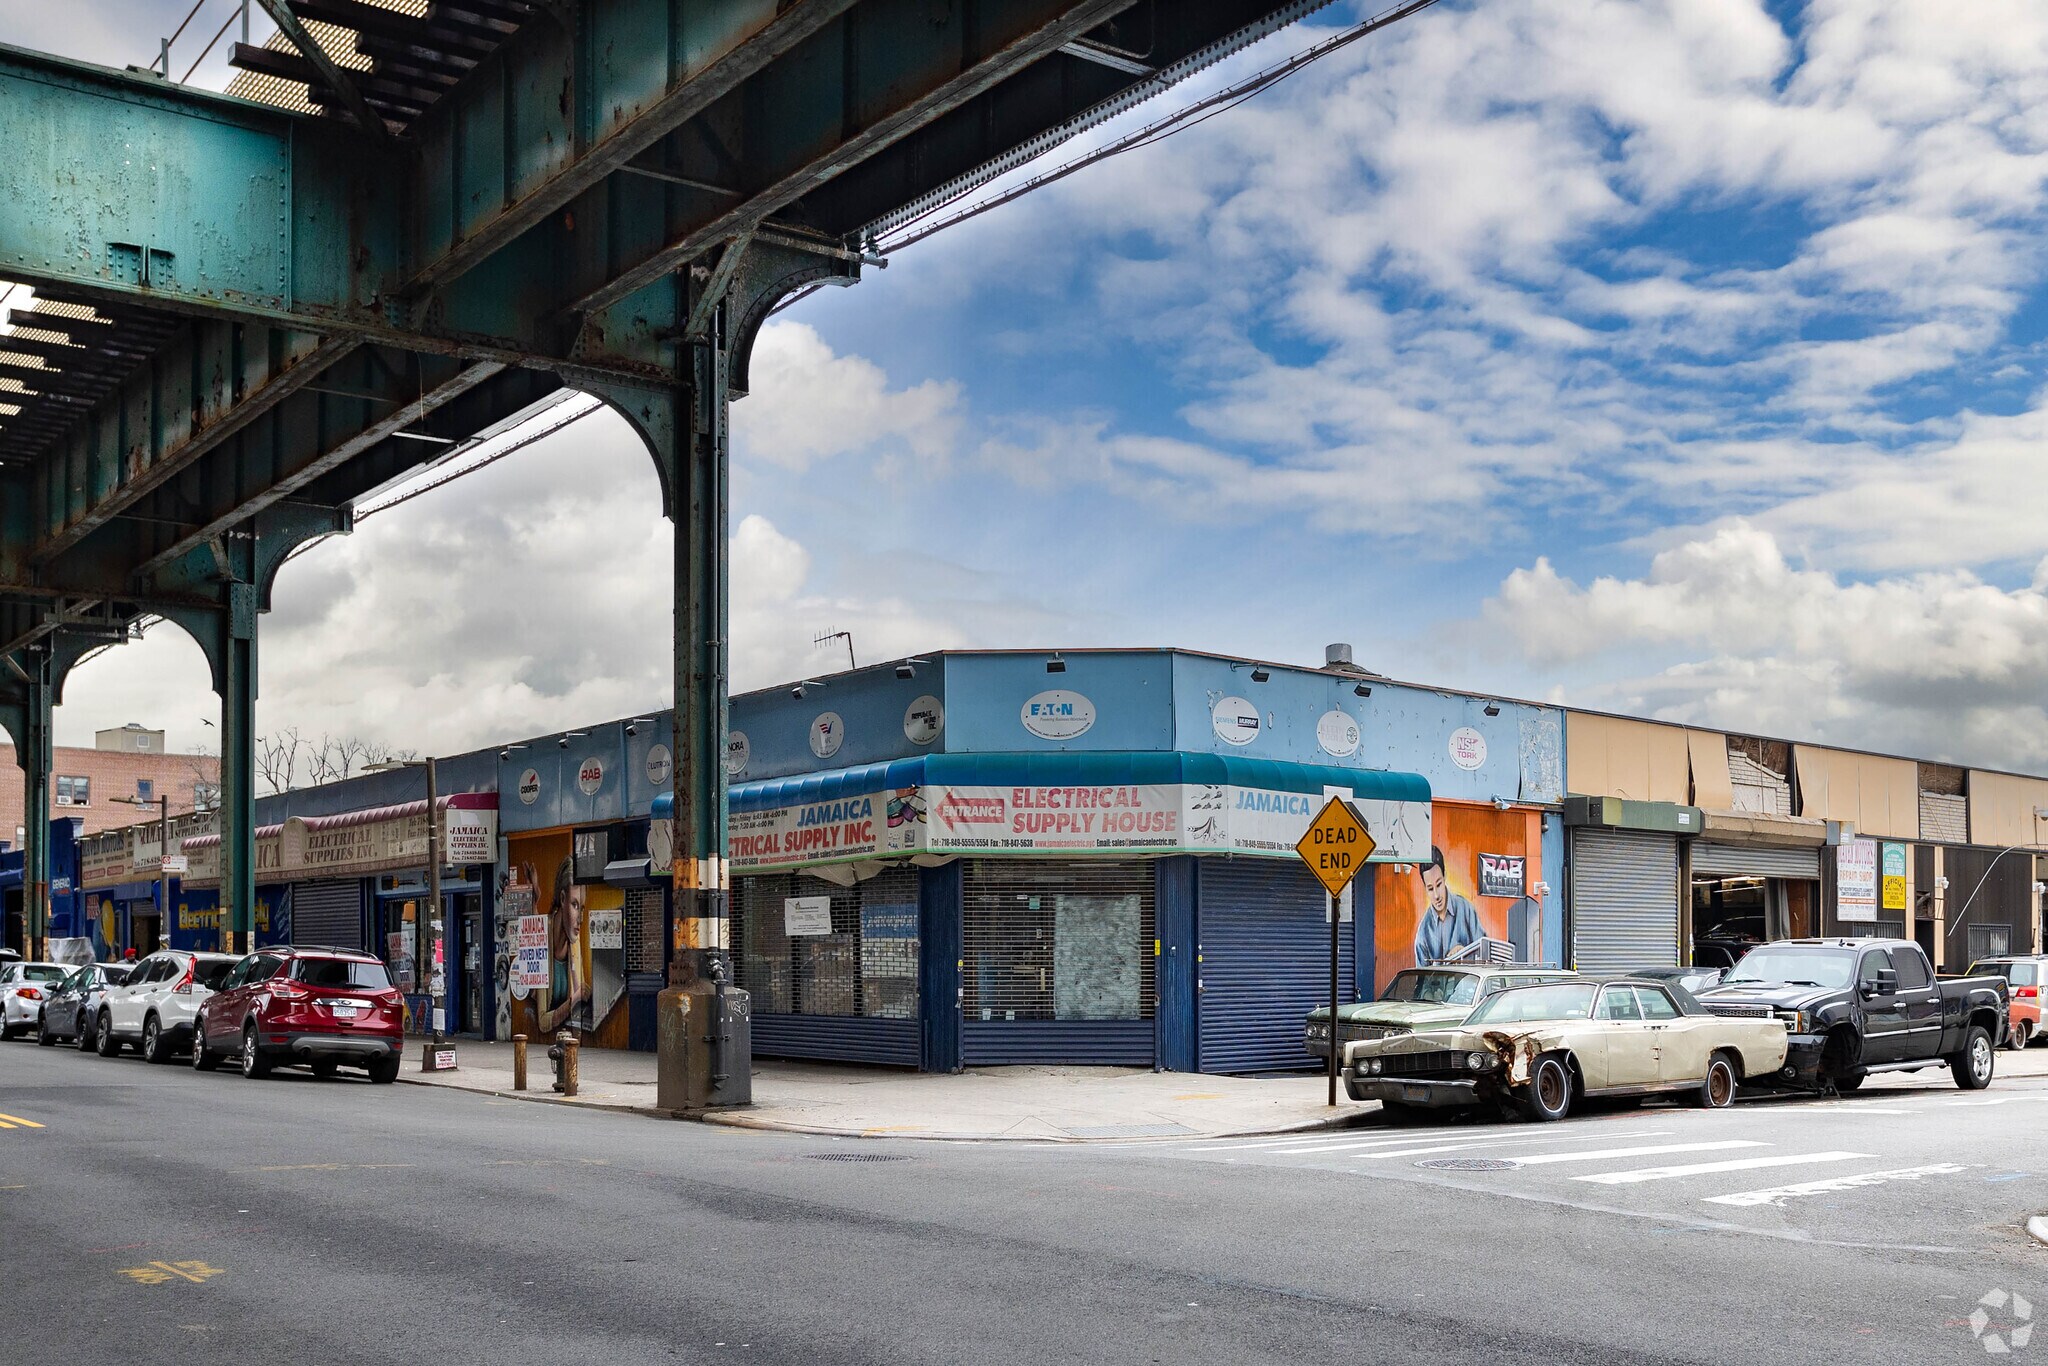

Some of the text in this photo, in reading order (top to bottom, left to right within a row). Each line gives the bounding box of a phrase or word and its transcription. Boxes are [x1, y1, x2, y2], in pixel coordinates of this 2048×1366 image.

[1031, 703, 1073, 716] EATON
[1457, 750, 1477, 759] TORK
[581, 768, 601, 781] RAB
[520, 784, 538, 794] COOPER
[1012, 787, 1141, 809] ELECTRICAL
[1235, 790, 1310, 816] JAMAICA
[797, 797, 872, 827] JAMAICA
[943, 805, 1002, 817] ENTRANCE
[1012, 811, 1177, 833] SUPPLY HOUSE
[450, 826, 488, 835] JAMAICA
[784, 825, 841, 853] SUPPLY
[844, 820, 876, 845] INC.
[1314, 827, 1357, 844] DEAD
[308, 828, 372, 849] ELECTRICAL
[1112, 838, 1177, 847] sales@jamaicaelectric.nyc
[303, 844, 378, 864] SUPPLIES INC.
[1319, 852, 1351, 869] END
[1484, 857, 1524, 879] RAB
[1483, 876, 1523, 885] LIGHTING
[1859, 871, 1873, 882] SHOP
[1885, 878, 1903, 892] OFFICIAL
[521, 917, 545, 935] JAMAICA
[495, 941, 509, 954] DVR
[519, 948, 548, 960] MOVED NEXT
[527, 961, 540, 973] DOOR
